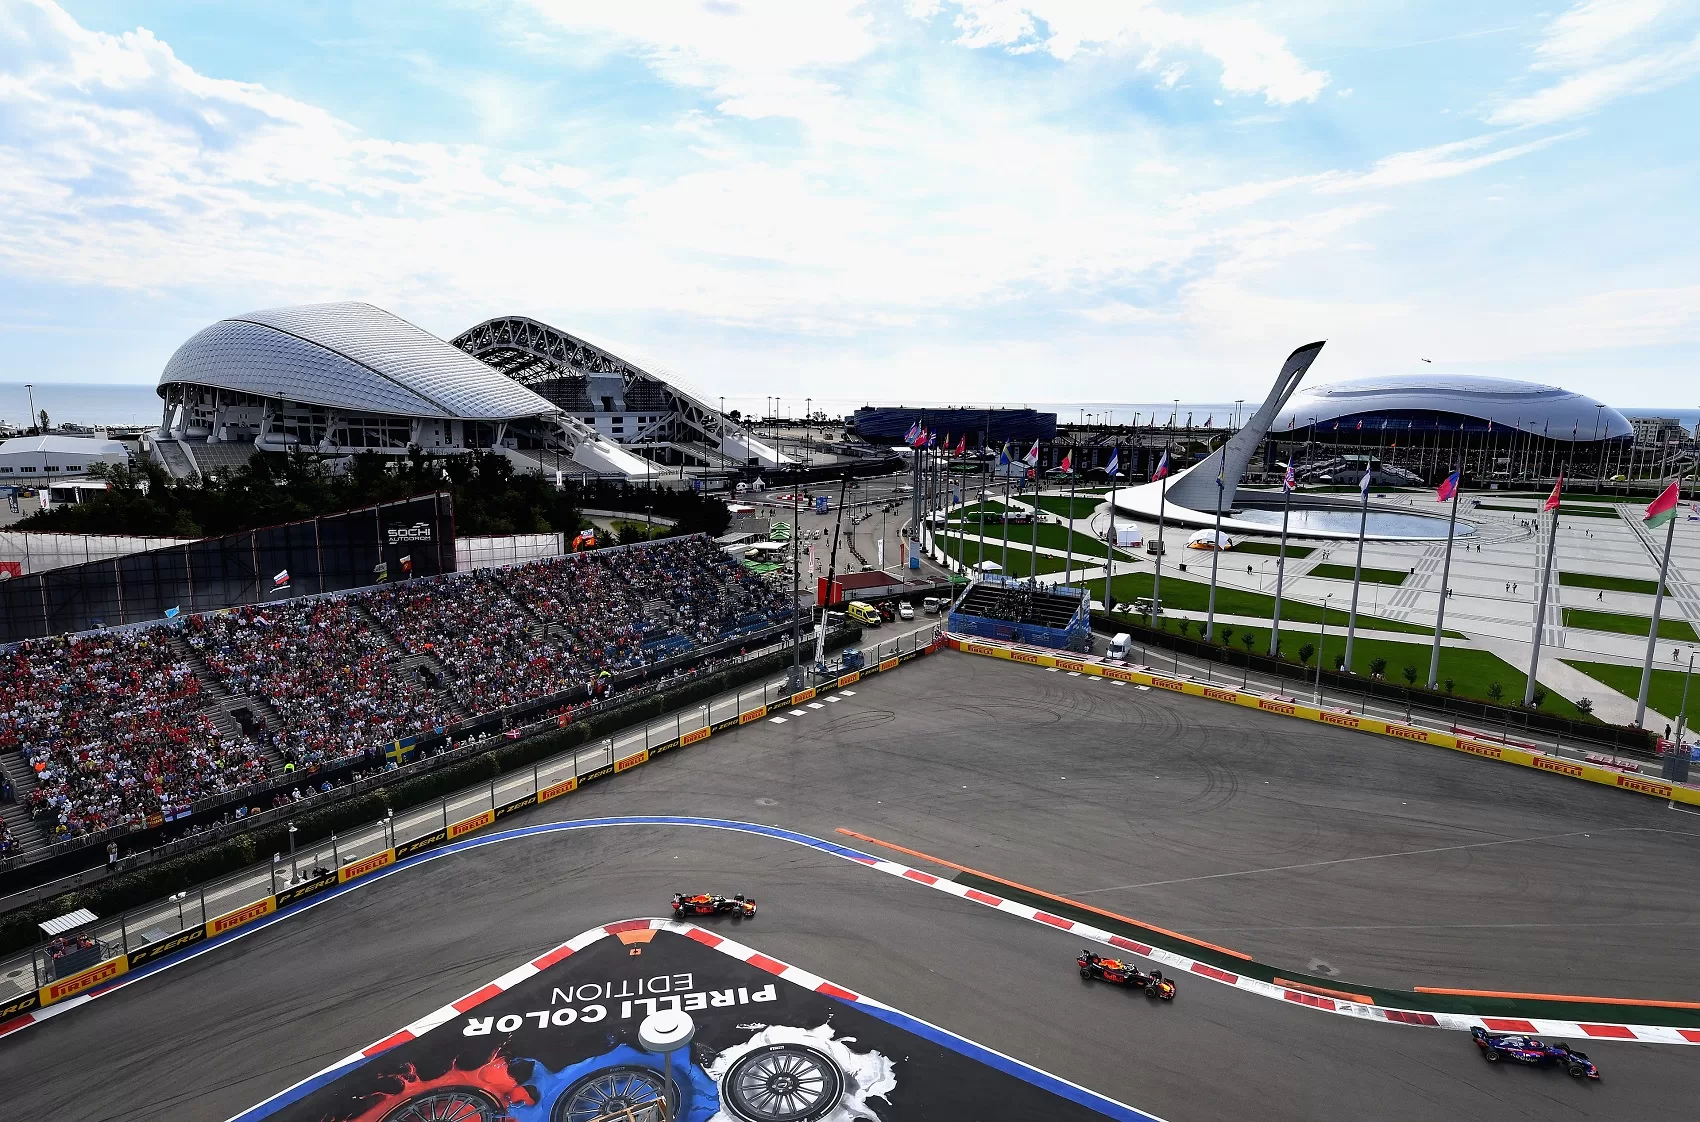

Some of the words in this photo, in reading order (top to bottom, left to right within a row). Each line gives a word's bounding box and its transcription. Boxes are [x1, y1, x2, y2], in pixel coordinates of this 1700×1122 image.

[388, 528, 430, 536] SOCHI
[1010, 652, 1037, 663] PIRELLI
[1056, 659, 1084, 671] PIRELLI
[1102, 668, 1132, 681] PIRELLI
[1152, 677, 1183, 691] PIRELLI
[1204, 688, 1237, 702] PIRELLI
[1259, 700, 1295, 714] PIRELLI
[1319, 713, 1359, 728] PIRELLI
[683, 728, 708, 744] PIRELLI
[1386, 725, 1428, 741] PIRELLI
[657, 740, 680, 753] ZERO
[1456, 739, 1502, 758] PIRELLI
[619, 752, 645, 771] PIRELLI
[1533, 757, 1583, 777] PIRELLI
[586, 766, 613, 781] ZERO
[542, 780, 573, 801] PIRELLI
[1617, 776, 1672, 797] PIRELLI
[497, 808, 505, 817] P
[507, 796, 536, 813] ZERO
[452, 813, 489, 836] PIRELLI
[398, 845, 408, 857] P
[409, 832, 446, 851] ZERO
[345, 853, 388, 879] PIRELLI
[279, 893, 291, 904] P
[295, 875, 337, 897] ZERO
[215, 901, 268, 932] PIRELLI
[132, 952, 147, 965] P
[150, 928, 204, 955] ZERO
[50, 962, 117, 999] PIRELLI
[551, 973, 693, 1004] EDITION
[0, 997, 36, 1017] RO
[621, 984, 778, 1018] PIRELLI
[462, 1004, 608, 1037] COLOR
